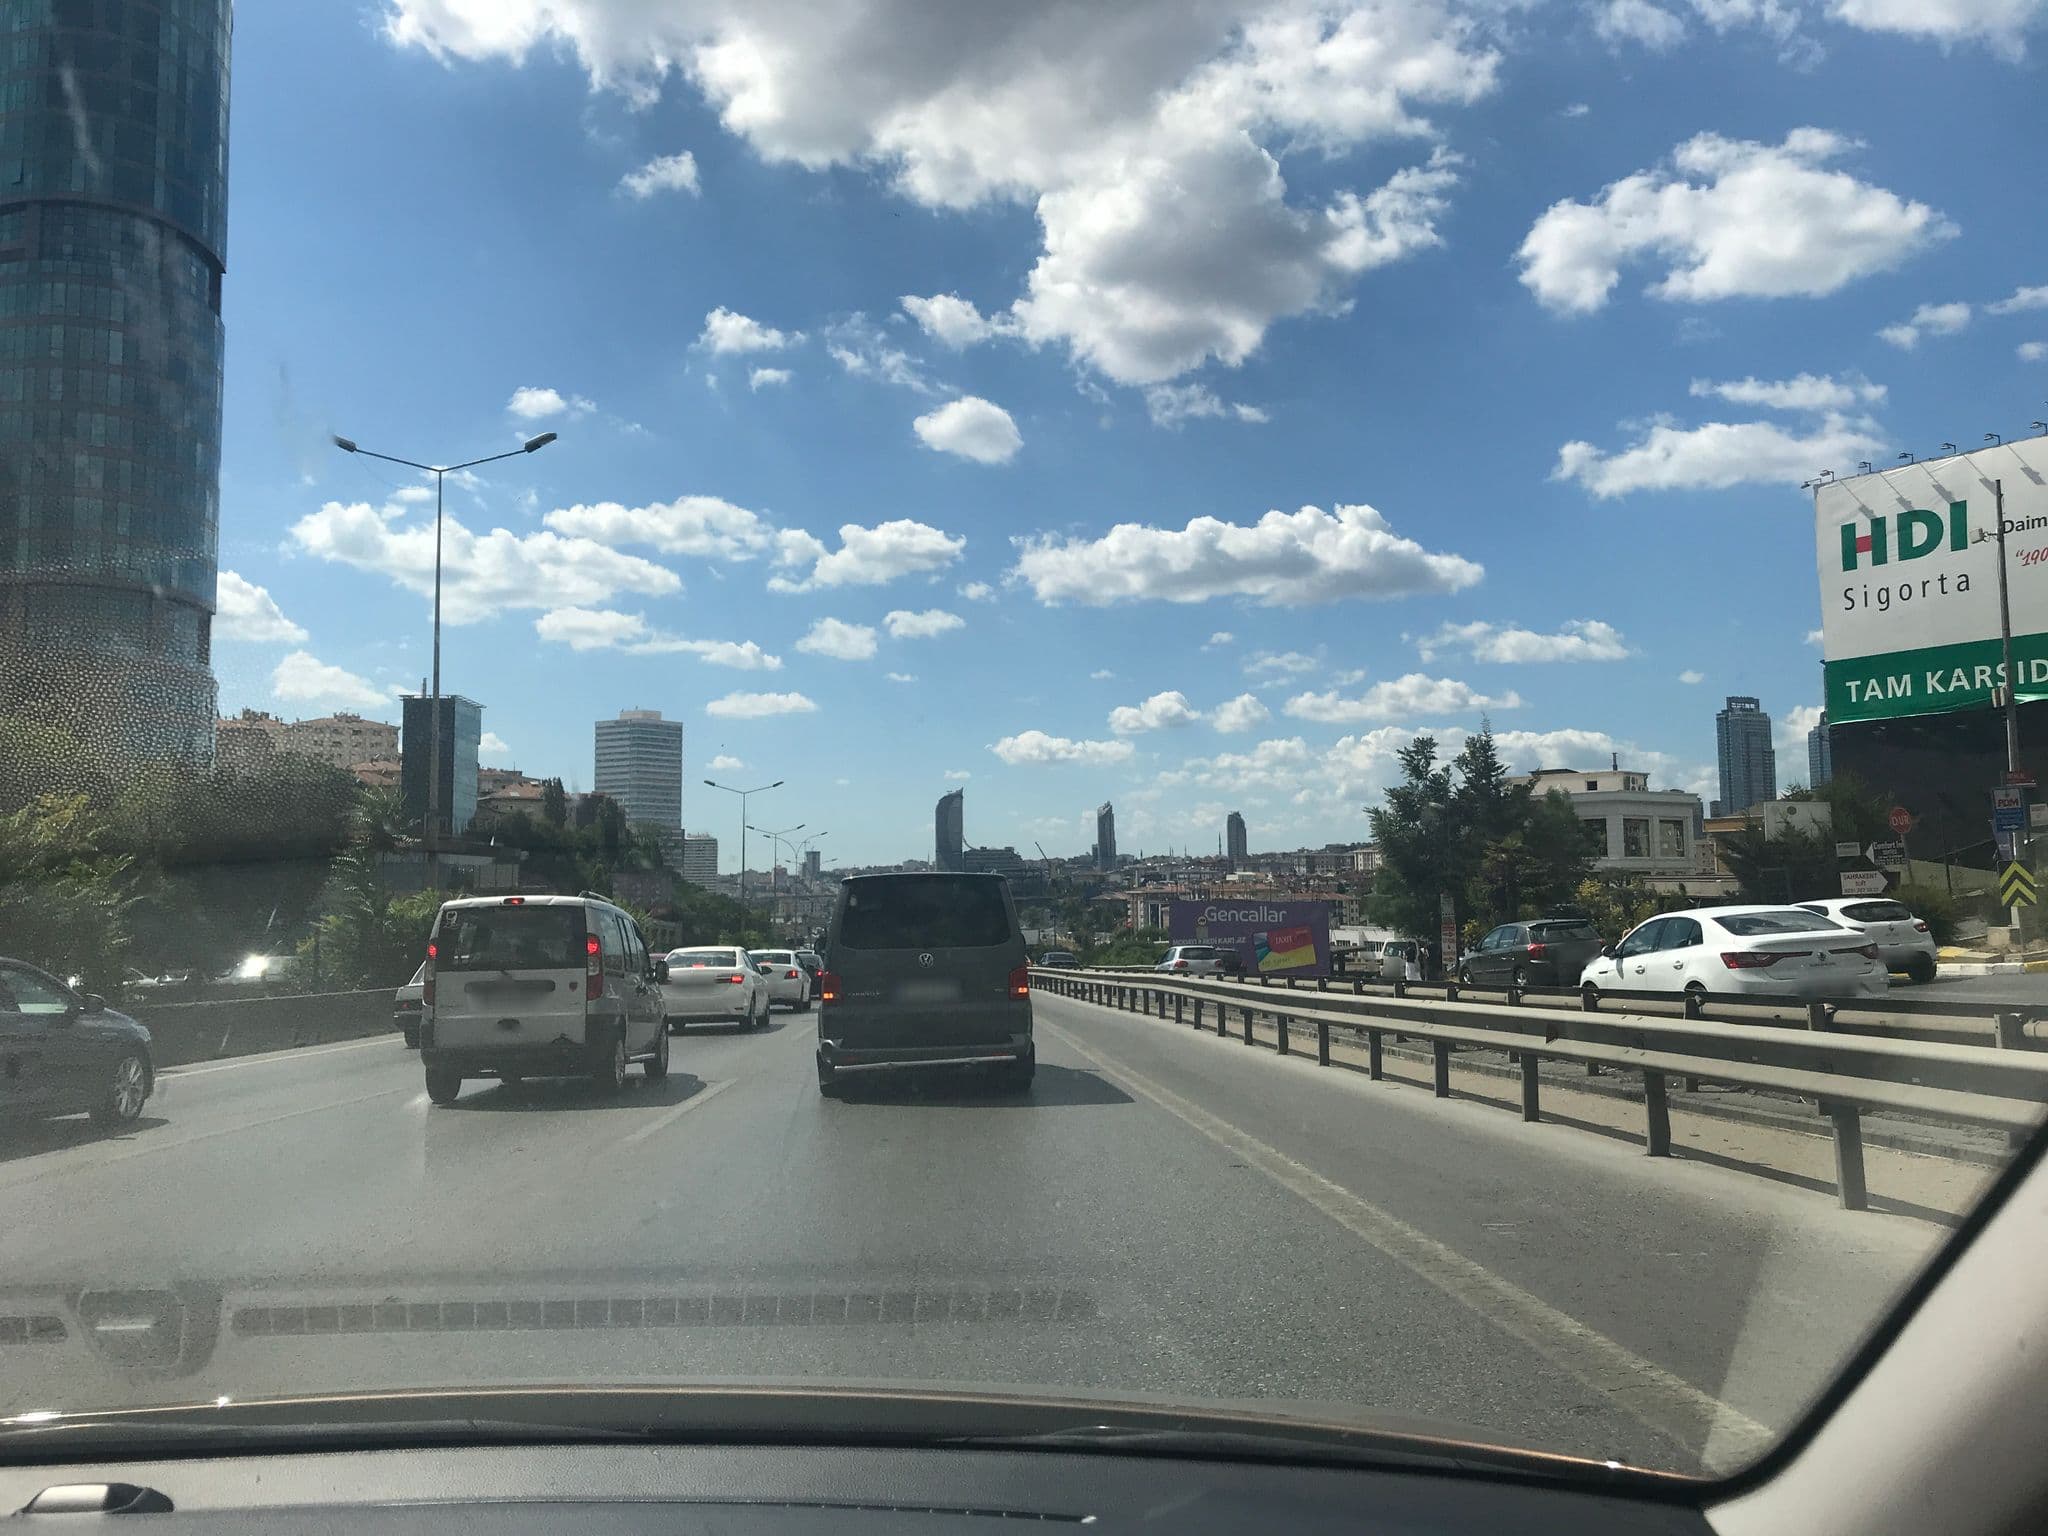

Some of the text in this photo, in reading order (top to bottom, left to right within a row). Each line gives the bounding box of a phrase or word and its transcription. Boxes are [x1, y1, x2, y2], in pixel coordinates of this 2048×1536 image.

[1841, 500, 1968, 572] HDI
[1843, 573, 1971, 612] Sigorta
[1846, 674, 1912, 703] TAM
[1891, 815, 1910, 826] DUR
[1205, 906, 1287, 923] Gencallar
